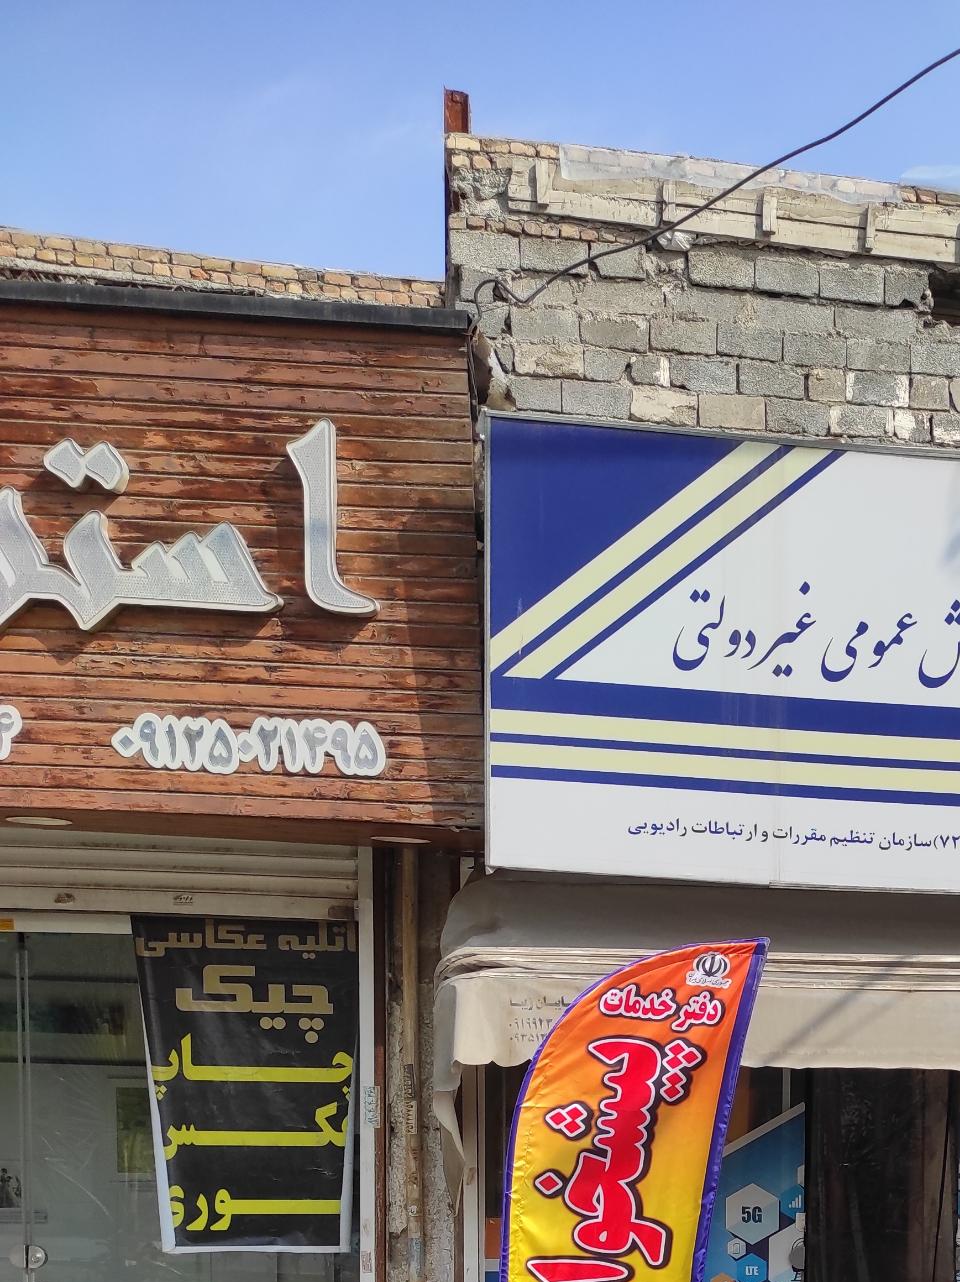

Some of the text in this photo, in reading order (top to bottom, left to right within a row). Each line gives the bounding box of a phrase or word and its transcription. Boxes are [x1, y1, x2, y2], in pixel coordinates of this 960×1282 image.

[820, 612, 918, 683] عمومی
[112, 712, 386, 775] ۰۹۱۲۵۰۲۱۴۹۵
[627, 817, 688, 837] رادیویی
[773, 827, 827, 847] مقررات
[829, 828, 874, 848] تنظیم
[135, 917, 267, 957] عکاسی
[175, 964, 334, 1044] چیک
[601, 985, 722, 1031] دفتر خدمات
[741, 1207, 763, 1225] 5G
[744, 1265, 760, 1277] LTE
